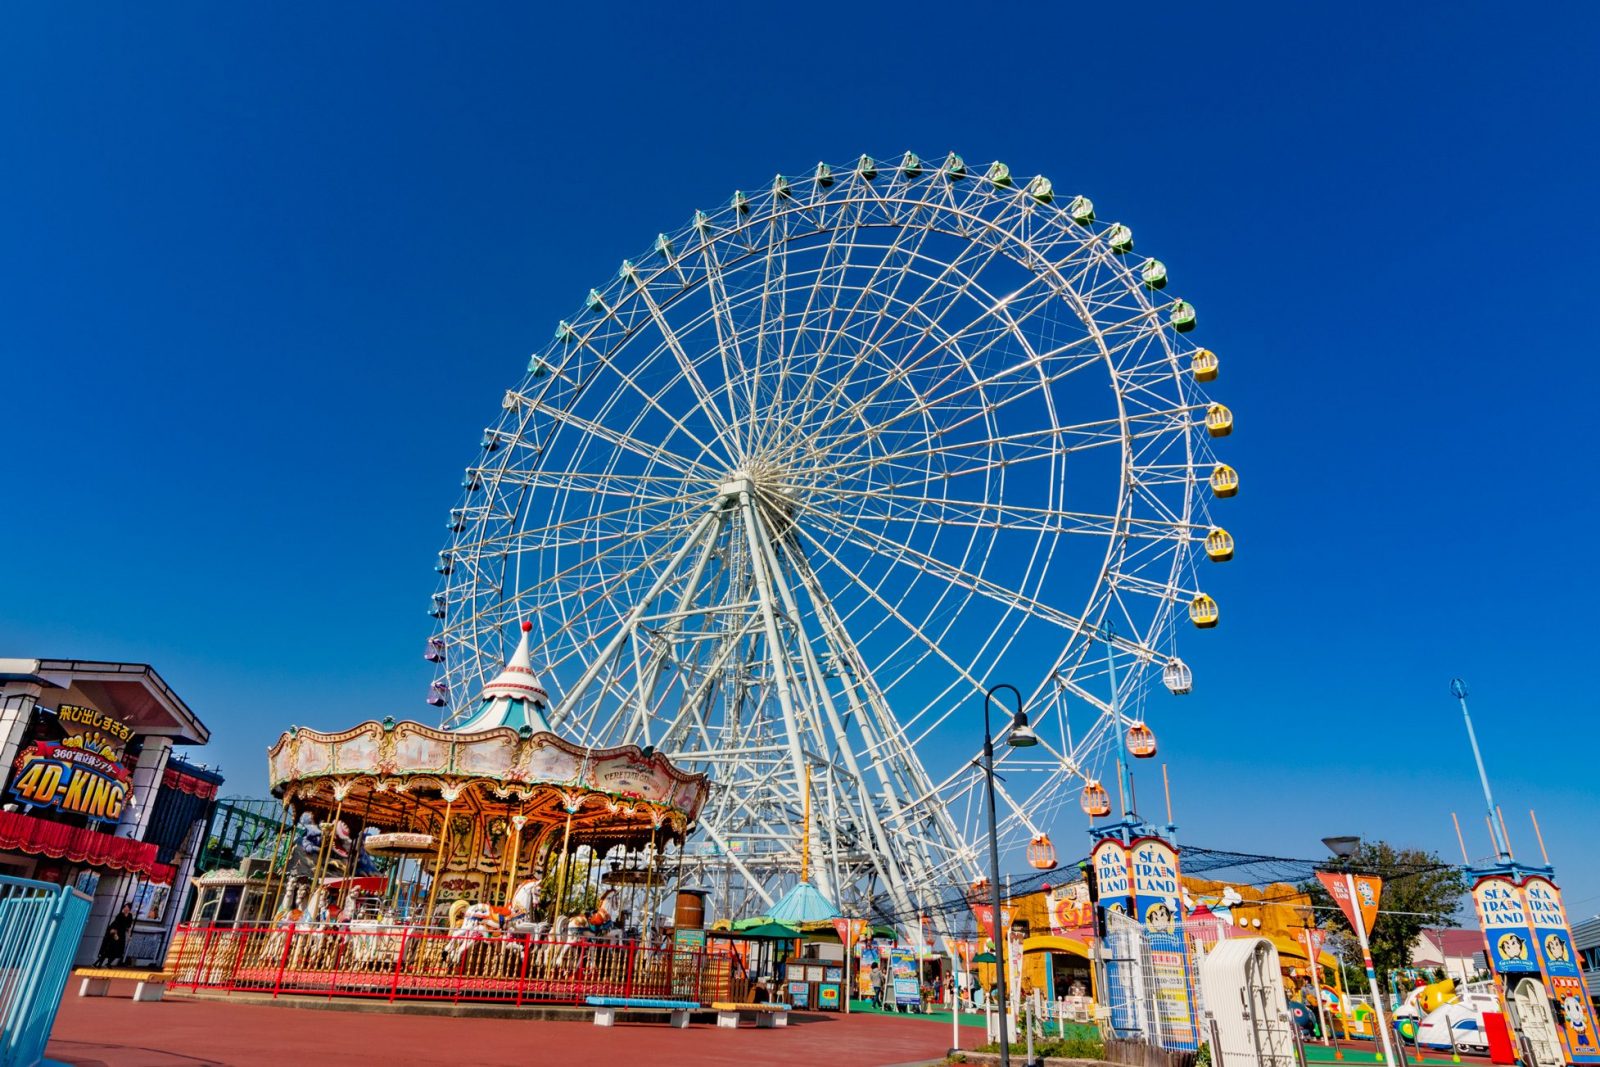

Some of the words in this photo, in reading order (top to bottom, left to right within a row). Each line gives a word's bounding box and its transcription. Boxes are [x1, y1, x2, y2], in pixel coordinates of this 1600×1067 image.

[17, 762, 123, 819] 4D-KING
[1101, 852, 1120, 866] SEA
[1139, 850, 1166, 864] SEA
[1098, 865, 1127, 880] TRAIN
[1134, 864, 1175, 878] TRAIN
[1100, 879, 1127, 893] LAND
[1137, 878, 1175, 893] LAND
[1484, 888, 1511, 900] SEA
[1529, 888, 1551, 900] SEA
[1482, 900, 1522, 912] TRAIN
[1528, 900, 1560, 912] TRAIN
[1485, 912, 1524, 925] LAND
[1532, 913, 1563, 925] LAND
